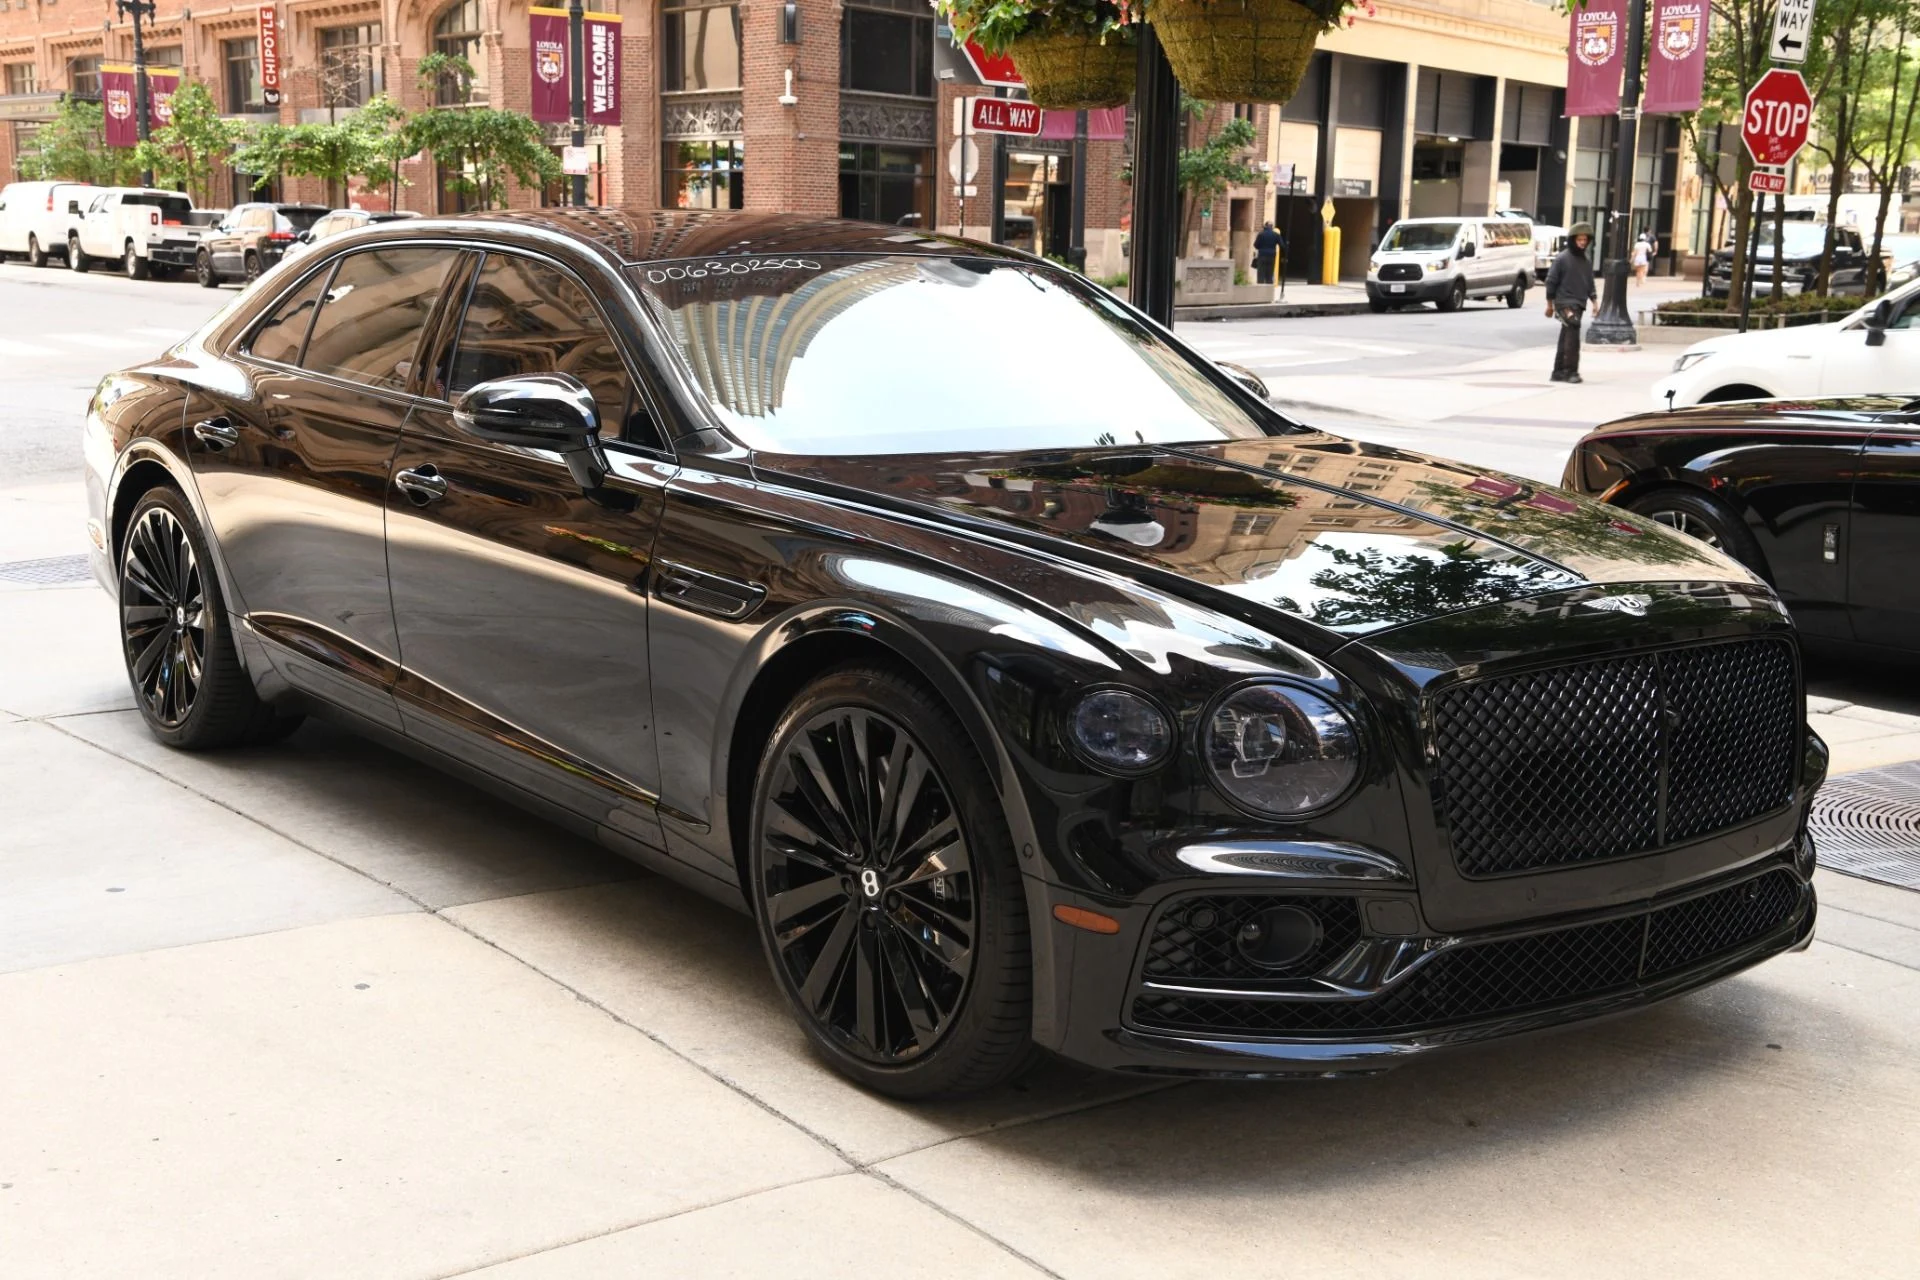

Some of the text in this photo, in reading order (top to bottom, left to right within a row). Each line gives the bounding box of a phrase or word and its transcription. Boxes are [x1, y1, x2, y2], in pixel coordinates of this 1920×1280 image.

[1578, 11, 1617, 22] LOYOLA
[1661, 4, 1701, 16] LOYOLA
[1780, 10, 1809, 31] WAY
[262, 10, 276, 85] CHIPOTLE
[536, 41, 563, 49] LOYOLA
[592, 24, 606, 113] WELCOME
[978, 104, 1035, 128] ALL WAY
[1747, 98, 1808, 138] STOP
[1752, 175, 1784, 190] ALL WAY
[647, 258, 822, 284] 006302500
